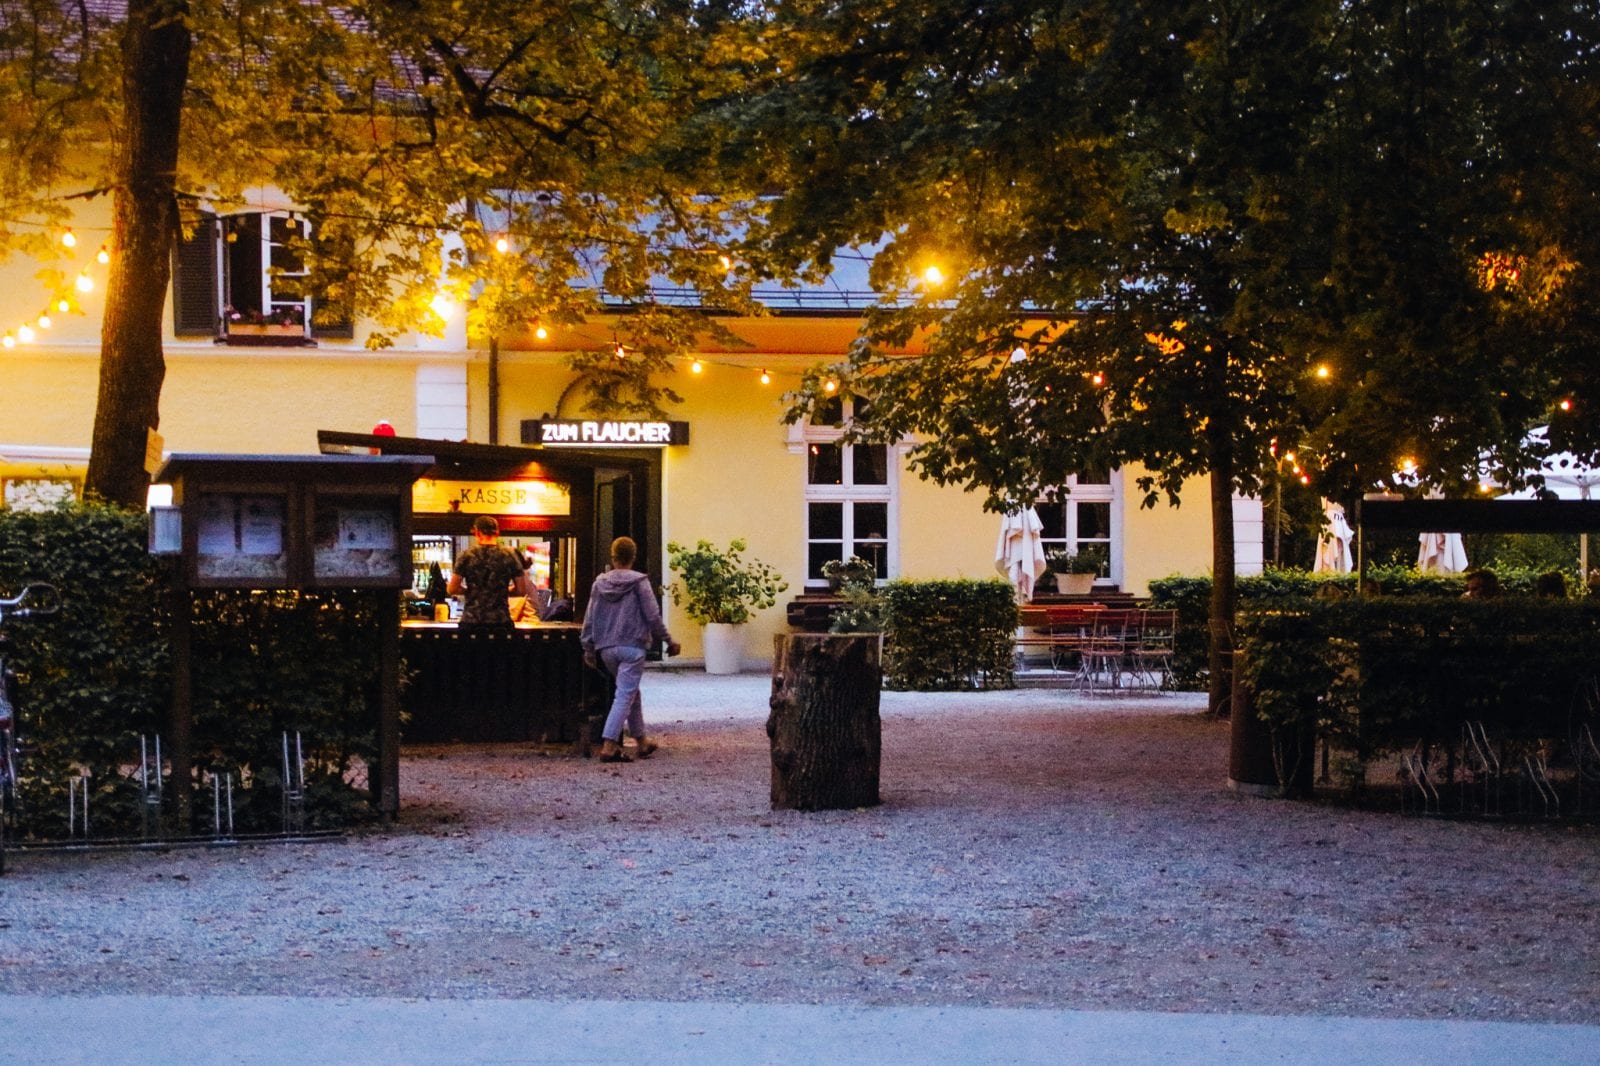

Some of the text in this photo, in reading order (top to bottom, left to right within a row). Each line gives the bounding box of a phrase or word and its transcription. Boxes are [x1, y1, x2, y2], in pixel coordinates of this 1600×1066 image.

[542, 421, 671, 442] ZUM FLAUCHER
[460, 488, 527, 505] KASSE
